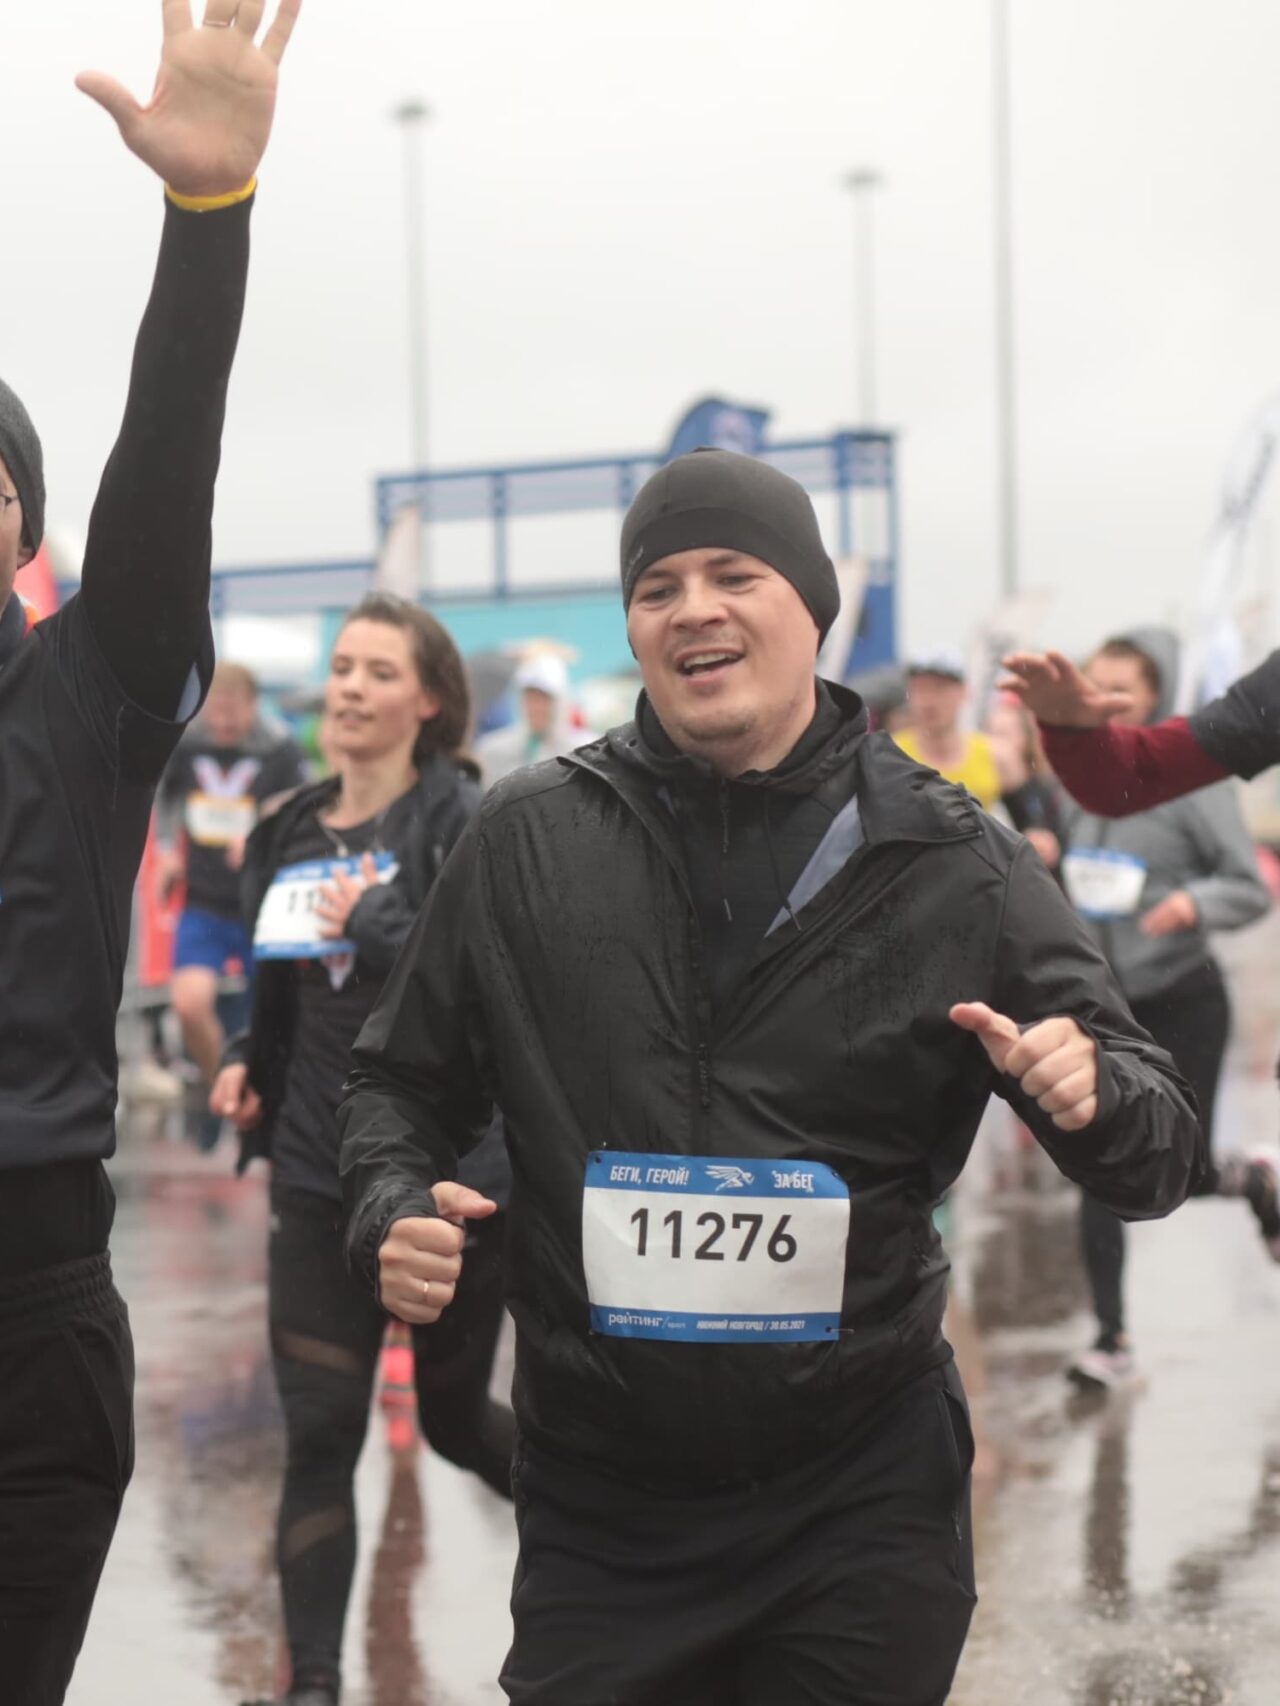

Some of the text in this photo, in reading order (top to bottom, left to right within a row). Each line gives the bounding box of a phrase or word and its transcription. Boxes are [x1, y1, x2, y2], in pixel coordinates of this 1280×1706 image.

[610, 1165, 690, 1185] БЕГИ, ГЕРОЙ!
[631, 1207, 797, 1263] 11276
